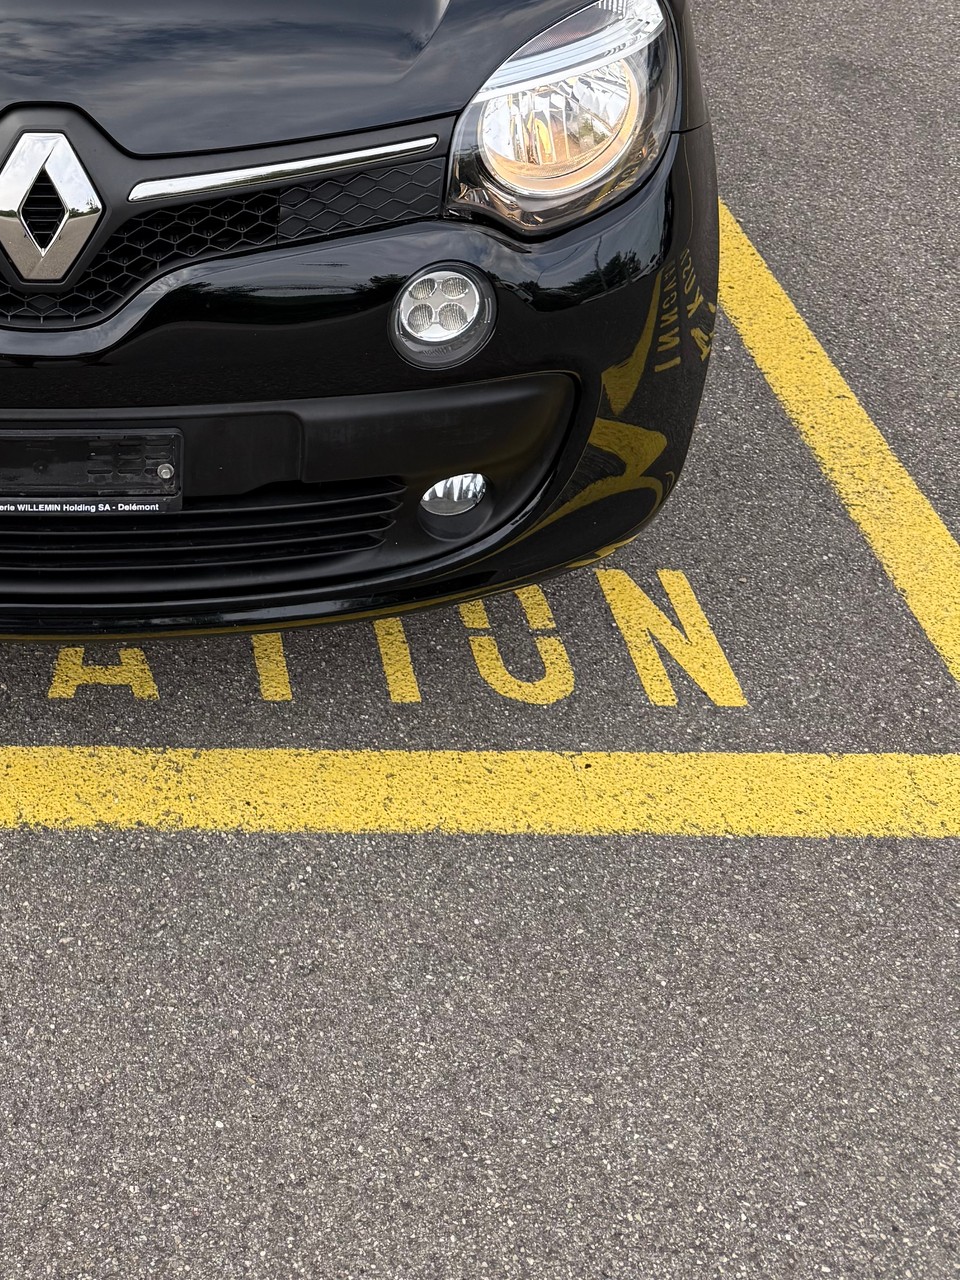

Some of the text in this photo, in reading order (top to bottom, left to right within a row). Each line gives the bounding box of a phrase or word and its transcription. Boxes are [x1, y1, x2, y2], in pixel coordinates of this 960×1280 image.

[17, 503, 61, 512] WILLEMIN
[63, 503, 96, 513] Holding
[98, 503, 111, 512] SA
[118, 502, 159, 512] Delémont
